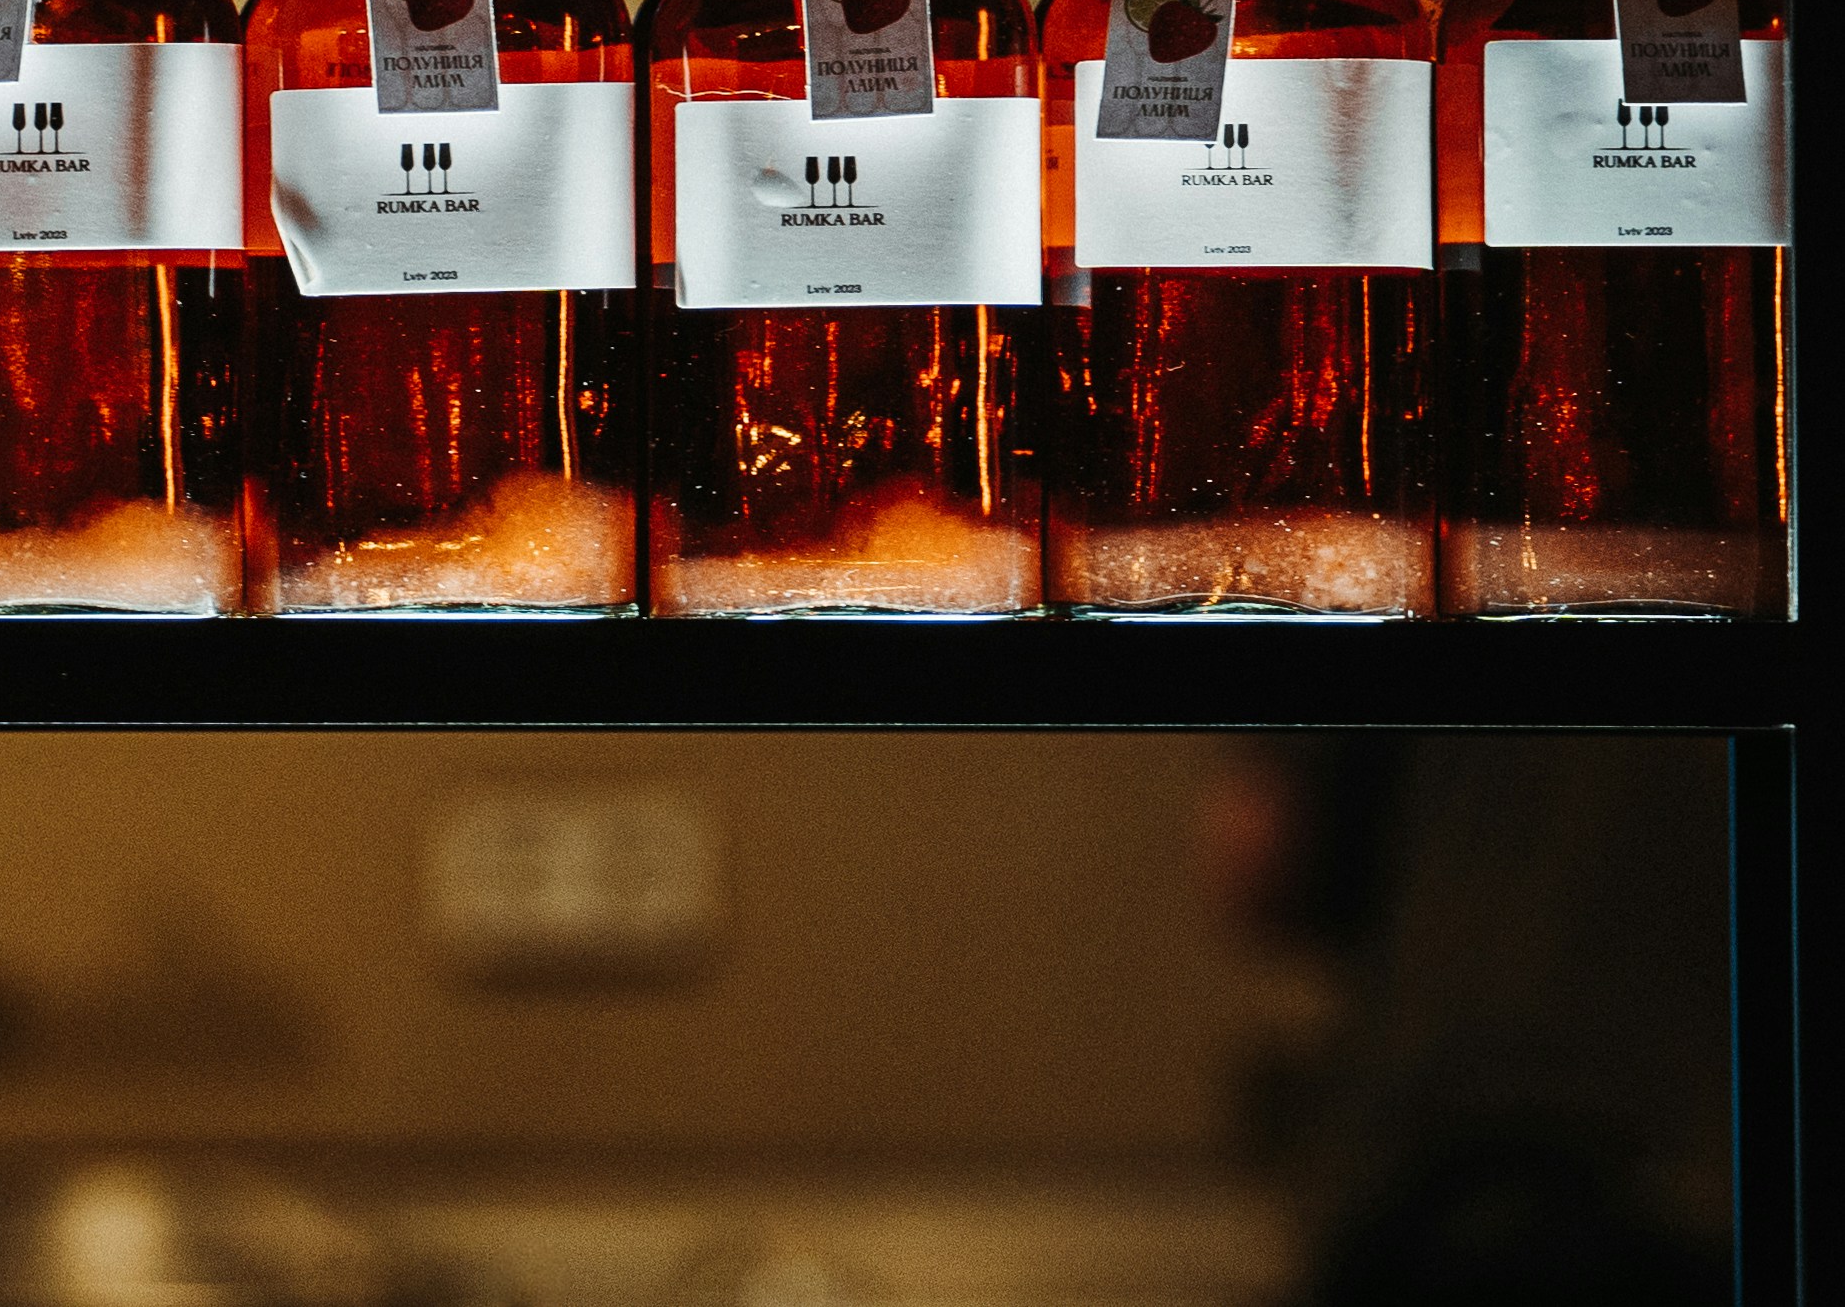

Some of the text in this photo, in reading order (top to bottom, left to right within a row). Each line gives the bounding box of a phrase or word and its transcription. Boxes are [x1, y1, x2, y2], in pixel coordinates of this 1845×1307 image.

[1631, 42, 1731, 59] ПОЛУНИЦЯ
[383, 54, 484, 71] ПОЛУНИЦЯ
[817, 56, 919, 76] ПОЛУНИЦЯ
[412, 72, 465, 88] ЛАЙМ
[1113, 85, 1214, 102] ПОЛУНИЦЯ
[55, 159, 91, 172] BAR
[1593, 155, 1697, 168] RUMKA BAR
[1181, 174, 1274, 186] RUMKA BAR
[377, 199, 481, 214] RUMKA BAR
[781, 213, 886, 226] RUMKA BAR
[1618, 226, 1673, 236] Lviv 2023
[403, 270, 458, 281] Lviv 2023
